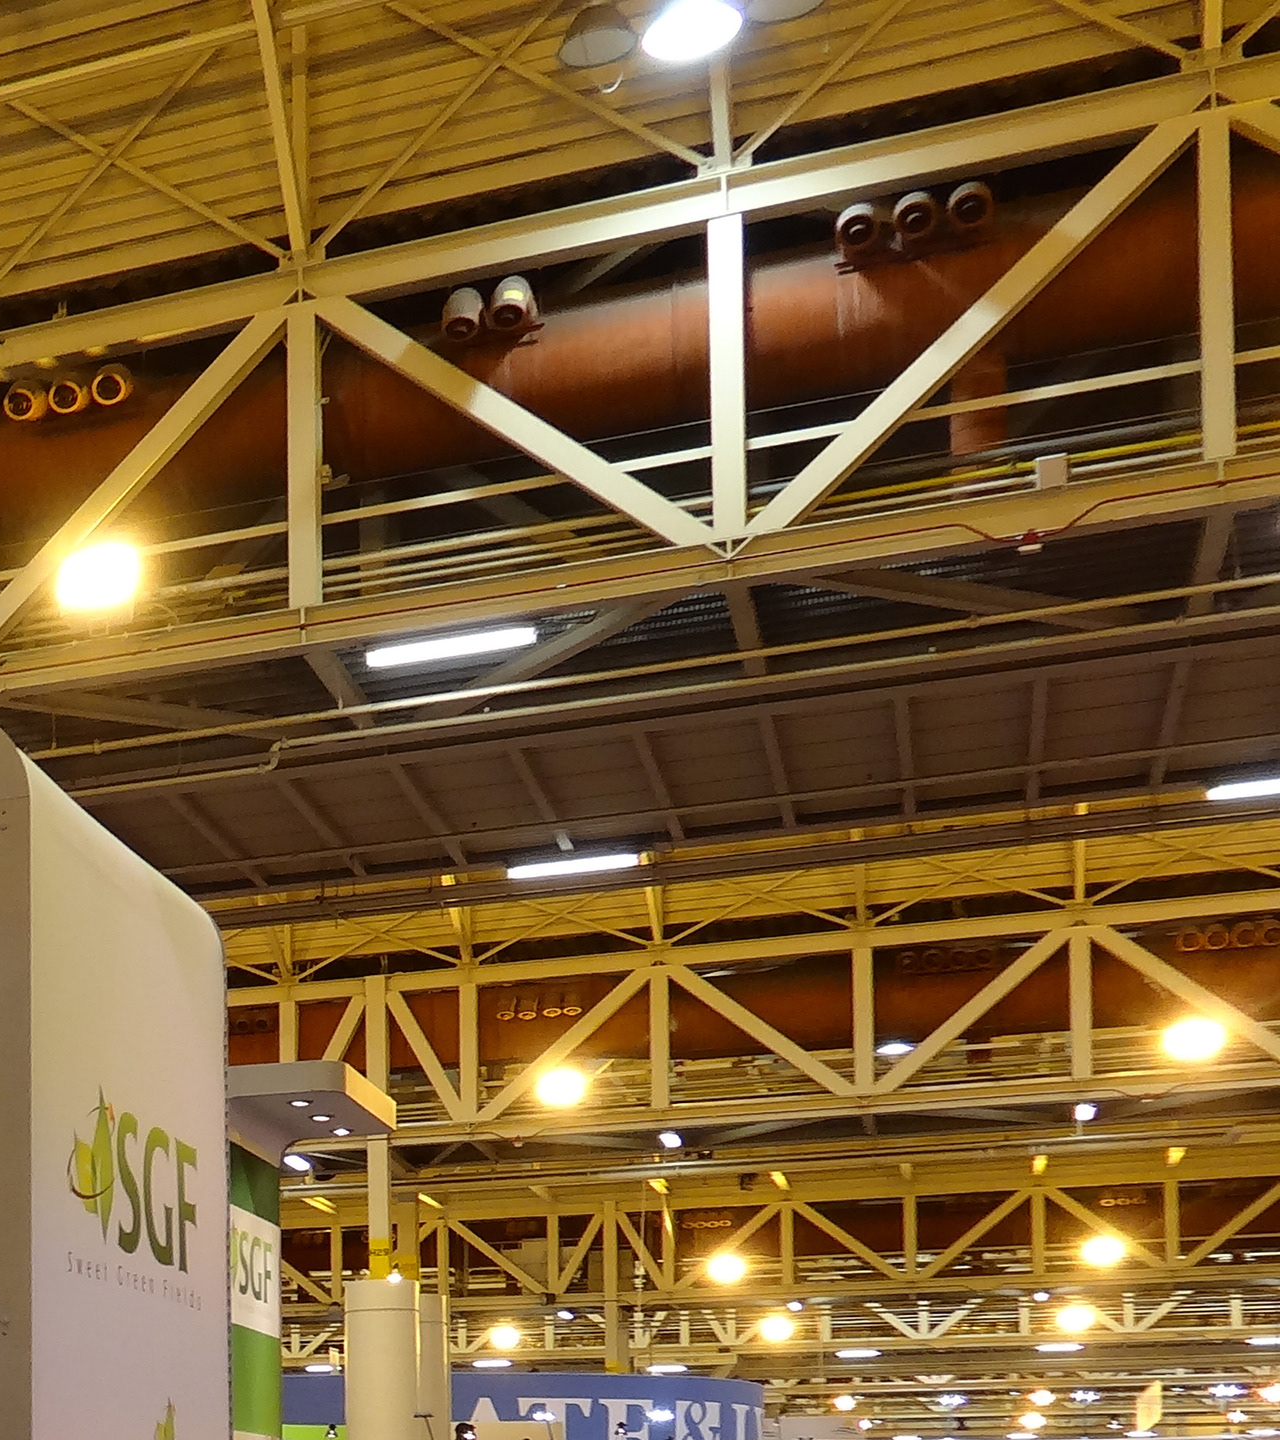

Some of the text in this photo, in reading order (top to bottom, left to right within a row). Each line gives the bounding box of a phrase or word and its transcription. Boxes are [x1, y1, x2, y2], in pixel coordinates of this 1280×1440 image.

[116, 1111, 199, 1276] SGF
[66, 1250, 203, 1312] Sweet Green Fields
[239, 1230, 273, 1304] SGF
